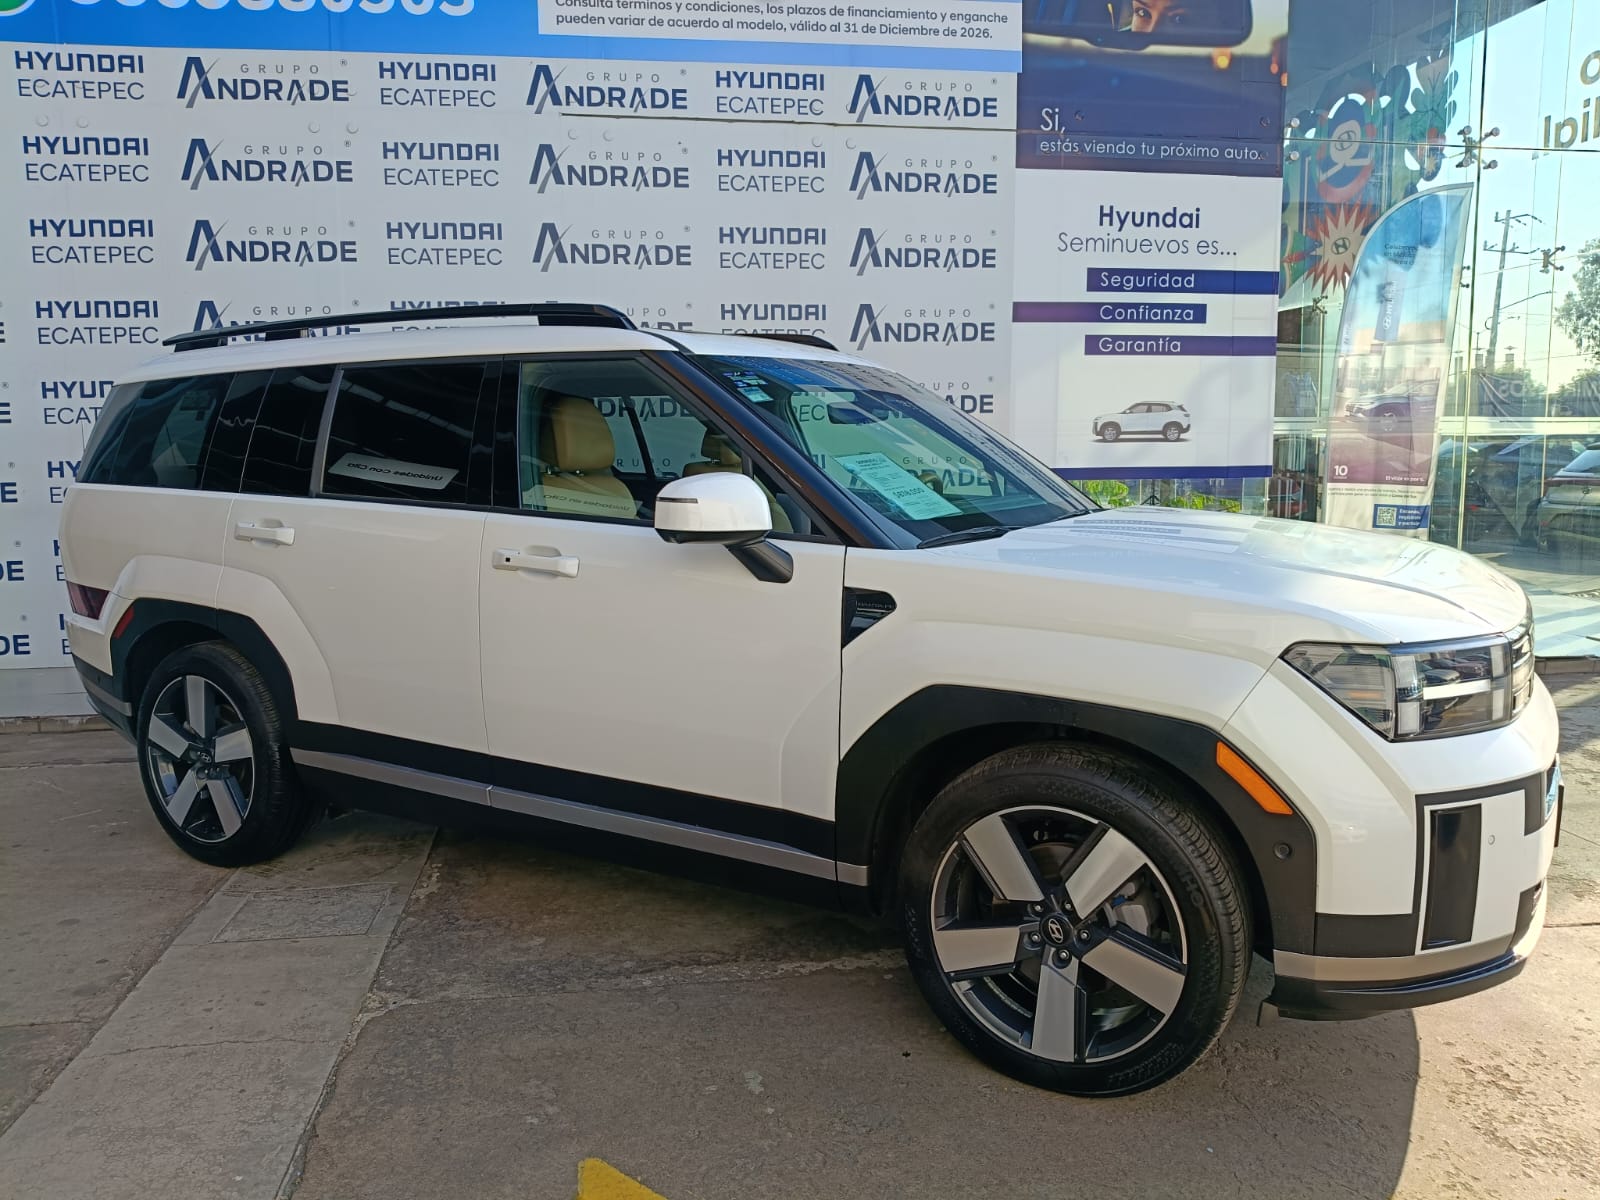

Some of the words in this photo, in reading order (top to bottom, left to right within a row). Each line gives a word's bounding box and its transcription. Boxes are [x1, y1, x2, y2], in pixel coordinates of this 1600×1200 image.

[675, 2, 683, 13] y
[685, 1, 764, 15] condiciones,
[766, 3, 784, 14] los
[787, 4, 826, 17] plazos
[829, 6, 845, 17] de
[847, 6, 938, 21] financiamiento
[940, 12, 947, 23] y
[950, 12, 1008, 26] enganche
[556, 13, 606, 26] pueden
[608, 15, 645, 26] variar
[648, 16, 664, 27] de
[667, 17, 720, 29] acuerdo
[722, 18, 734, 29] al
[736, 19, 787, 32] modelo,
[789, 20, 827, 32] válido
[829, 22, 841, 33] al
[844, 23, 858, 33] 31
[861, 23, 877, 34] de
[879, 23, 940, 37] Diciembre
[943, 26, 958, 37] de
[960, 28, 993, 39] 2026.
[14, 50, 144, 73] HYUNDAI
[240, 64, 318, 74] GRUPO
[379, 61, 496, 81] HYUNDAI
[177, 56, 350, 108] ANDRADE
[587, 72, 659, 83] GRUPO
[716, 70, 824, 91] HYUNDAI
[905, 82, 972, 92] GRUPO
[17, 79, 144, 100] ECATEPEC
[380, 88, 496, 107] ECATEPEC
[526, 64, 687, 115] ANDRADE
[848, 74, 997, 123] ANDRADE
[716, 97, 825, 116] ECATEPEC
[1040, 108, 1066, 133] Si,
[23, 136, 149, 156] HYUNDAI
[244, 145, 322, 155] GRUPO
[382, 142, 499, 161] HYUNDAI
[1040, 138, 1079, 152] estás
[1084, 139, 1136, 155] viendo
[1141, 142, 1155, 155] tu
[1160, 142, 1219, 159] próximo
[181, 138, 353, 190] ANDRADE
[589, 151, 661, 161] GRUPO
[717, 149, 825, 168] HYUNDAI
[905, 159, 972, 168] GRUPO
[25, 163, 149, 182] ECATEPEC
[384, 168, 499, 187] ECATEPEC
[529, 142, 689, 194] ANDRADE
[849, 151, 997, 200] ANDRADE
[719, 175, 824, 193] ECATEPEC
[29, 219, 153, 237] HYUNDAI
[1099, 205, 1200, 232] Hyundai
[249, 226, 326, 235] GRUPO
[386, 222, 502, 240] HYUNDAI
[592, 230, 663, 239] GRUPO
[719, 227, 826, 245] HYUNDAI
[905, 234, 971, 243] GRUPO
[185, 219, 357, 271] ANDRADE
[532, 222, 691, 272] ANDRADE
[849, 228, 996, 276] ANDRADE
[1057, 232, 1189, 253] Seminuevos
[1196, 239, 1237, 256] es...
[32, 246, 154, 263] ECATEPEC
[388, 248, 502, 265] ECATEPEC
[720, 252, 825, 269] ECATEPEC
[1100, 272, 1195, 290] Seguridad
[35, 300, 158, 319] HYUNDAI
[253, 306, 331, 315] GRUPO
[627, 308, 667, 317] UPO
[721, 304, 826, 320] HYUNDAI
[905, 309, 970, 317] GRUPO
[1100, 305, 1194, 321] Confianza
[38, 326, 159, 344] ECATEPEC
[849, 304, 995, 351] ANDRADE
[1099, 337, 1181, 352] Garantía
[41, 381, 114, 399] HYUN
[44, 407, 102, 424] ECAT
[1333, 464, 1348, 476] 10
